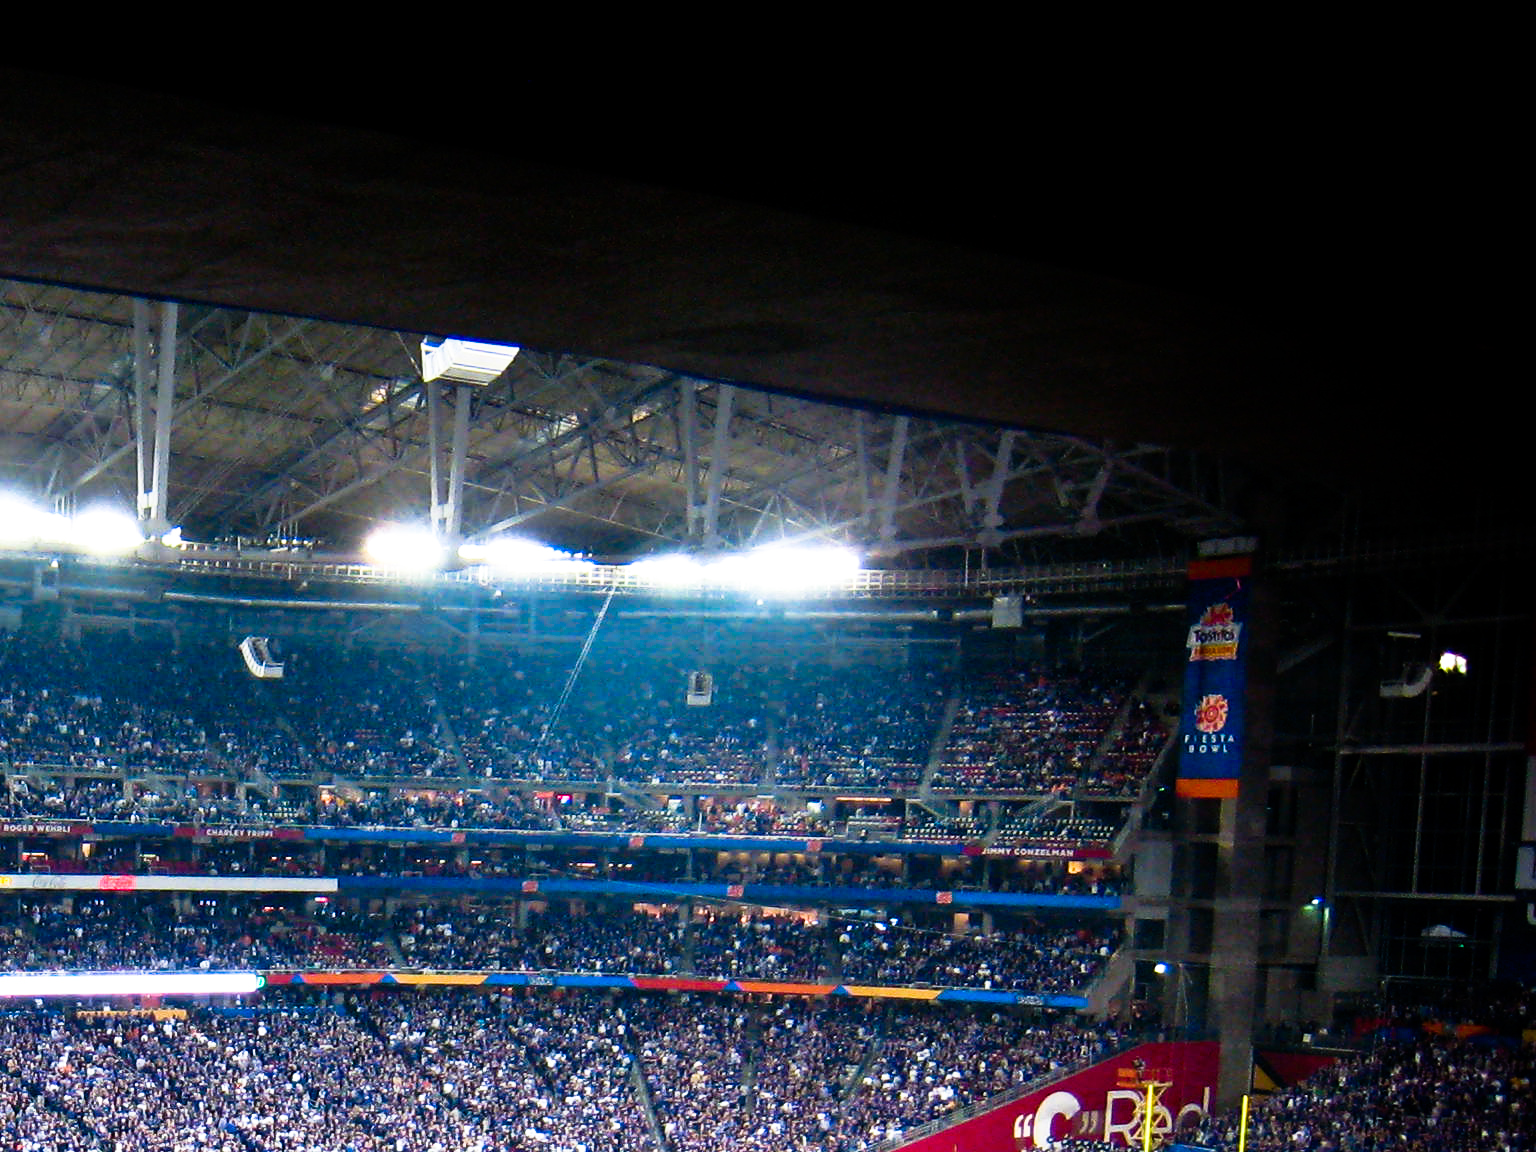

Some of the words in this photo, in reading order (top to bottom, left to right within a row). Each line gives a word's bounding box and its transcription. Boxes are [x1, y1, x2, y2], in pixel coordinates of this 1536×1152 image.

[1184, 734, 1235, 744] FIESTA
[1189, 744, 1228, 753] BOWL
[3, 824, 34, 832] ROGER
[36, 824, 71, 833] WEHRLI
[206, 828, 245, 837] CHARLEY
[982, 847, 1011, 855] JIMMY
[1014, 848, 1074, 857] CONZELMAN
